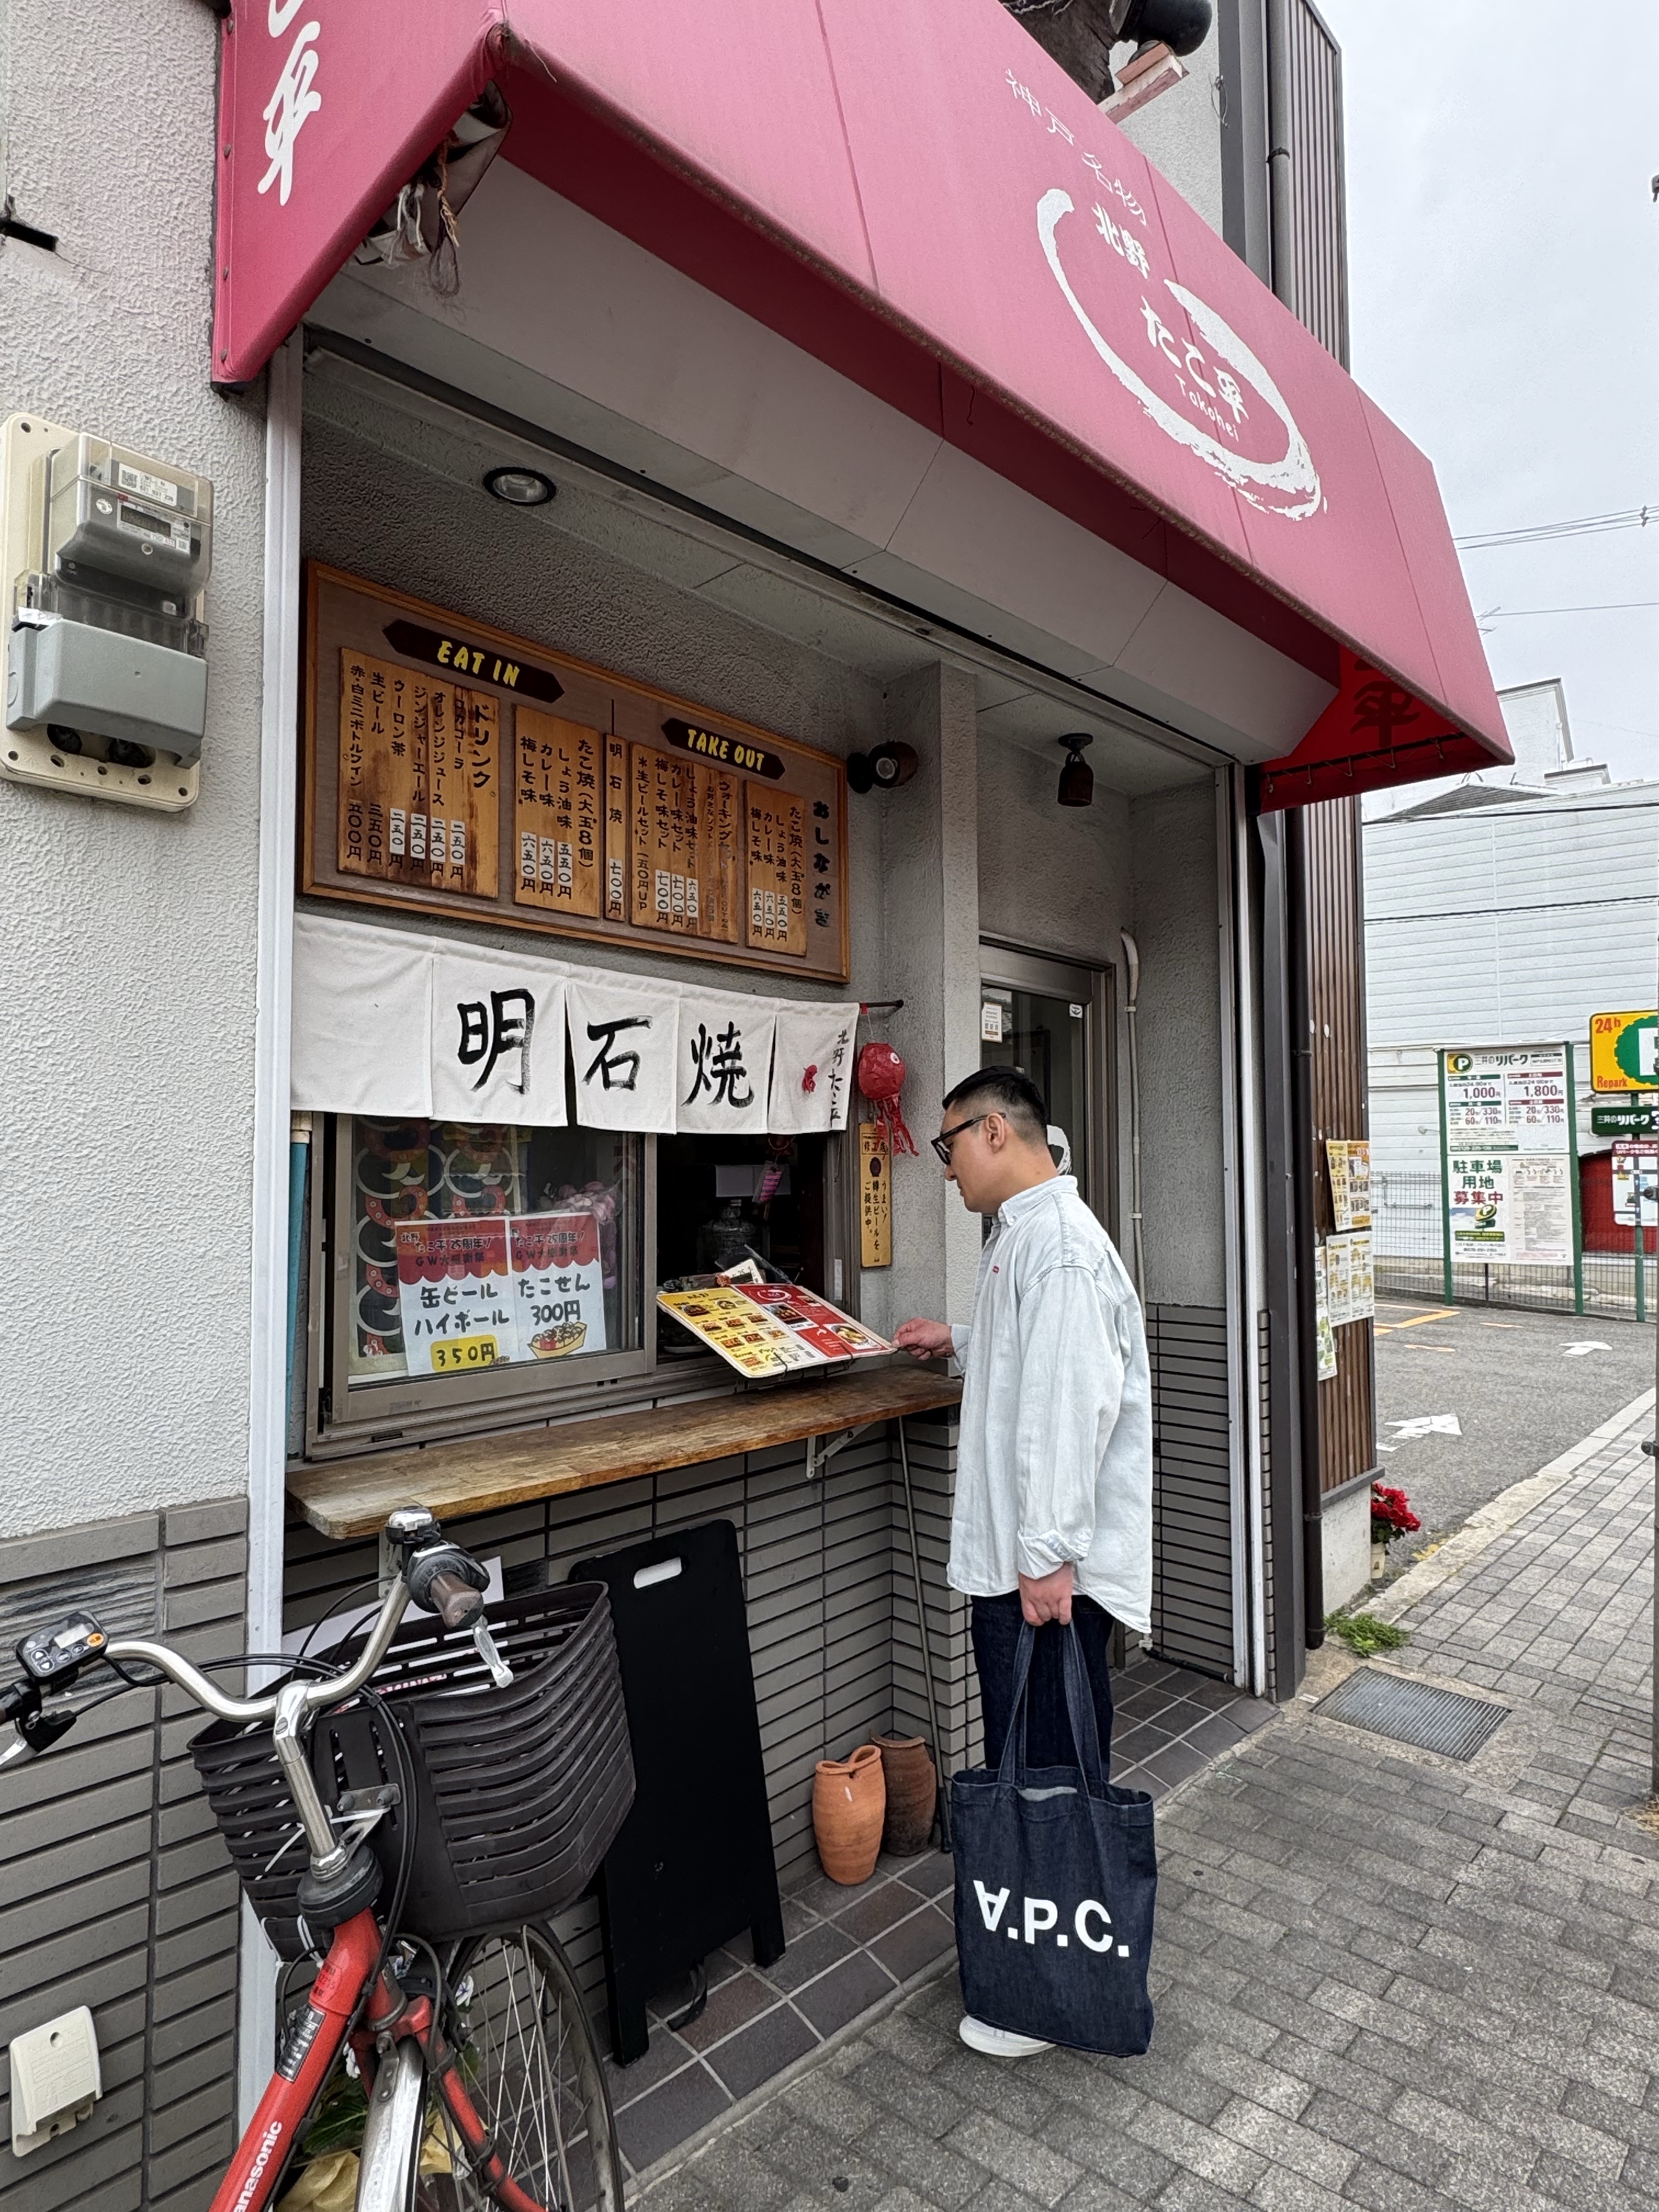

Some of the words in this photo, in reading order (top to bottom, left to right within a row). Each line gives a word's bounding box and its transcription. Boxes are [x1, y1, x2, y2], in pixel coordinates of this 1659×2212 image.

[1005, 68, 1146, 225] 神戸名物
[1095, 202, 1149, 279] 北野
[1175, 374, 1239, 442] Takohei
[437, 641, 485, 674] EAT
[493, 660, 520, 687] IN
[371, 672, 386, 735] 生ビール
[391, 679, 405, 757] ウーロン茶
[454, 698, 465, 770] コカコーラ
[412, 686, 427, 802] ジンジャーエール
[432, 692, 446, 806] オレンジジュース
[472, 704, 490, 788] ドリンク
[521, 736, 537, 803] 梅しそ味
[539, 744, 555, 808] カレー味
[687, 729, 729, 759] TAKE
[734, 746, 765, 771] OUT
[556, 748, 573, 829] しょう油味
[609, 743, 623, 824] 明石焼
[655, 757, 669, 849] 梅しそ味セット
[670, 764, 685, 853] カレー味セット
[751, 806, 763, 862] 梅しそ味
[764, 812, 775, 865] カレー味
[775, 814, 787, 883] しょう油味
[813, 800, 832, 927] おしながき
[457, 988, 755, 1109] 明石焼
[1475, 1053, 1528, 1066] 三井のリパーク
[1596, 1076, 1628, 1089] Repark
[1596, 1114, 1650, 1125] 三井のリパーク
[1453, 1160, 1503, 1173] 駐車場
[1453, 1191, 1503, 1204] 募集中
[1462, 1176, 1494, 1189] 用地
[420, 1283, 497, 1309] 缶ビール
[518, 1273, 590, 1299] たこせん
[530, 1300, 581, 1325] 300円
[415, 1309, 509, 1336] ハイボール
[436, 1342, 494, 1367] 350円
